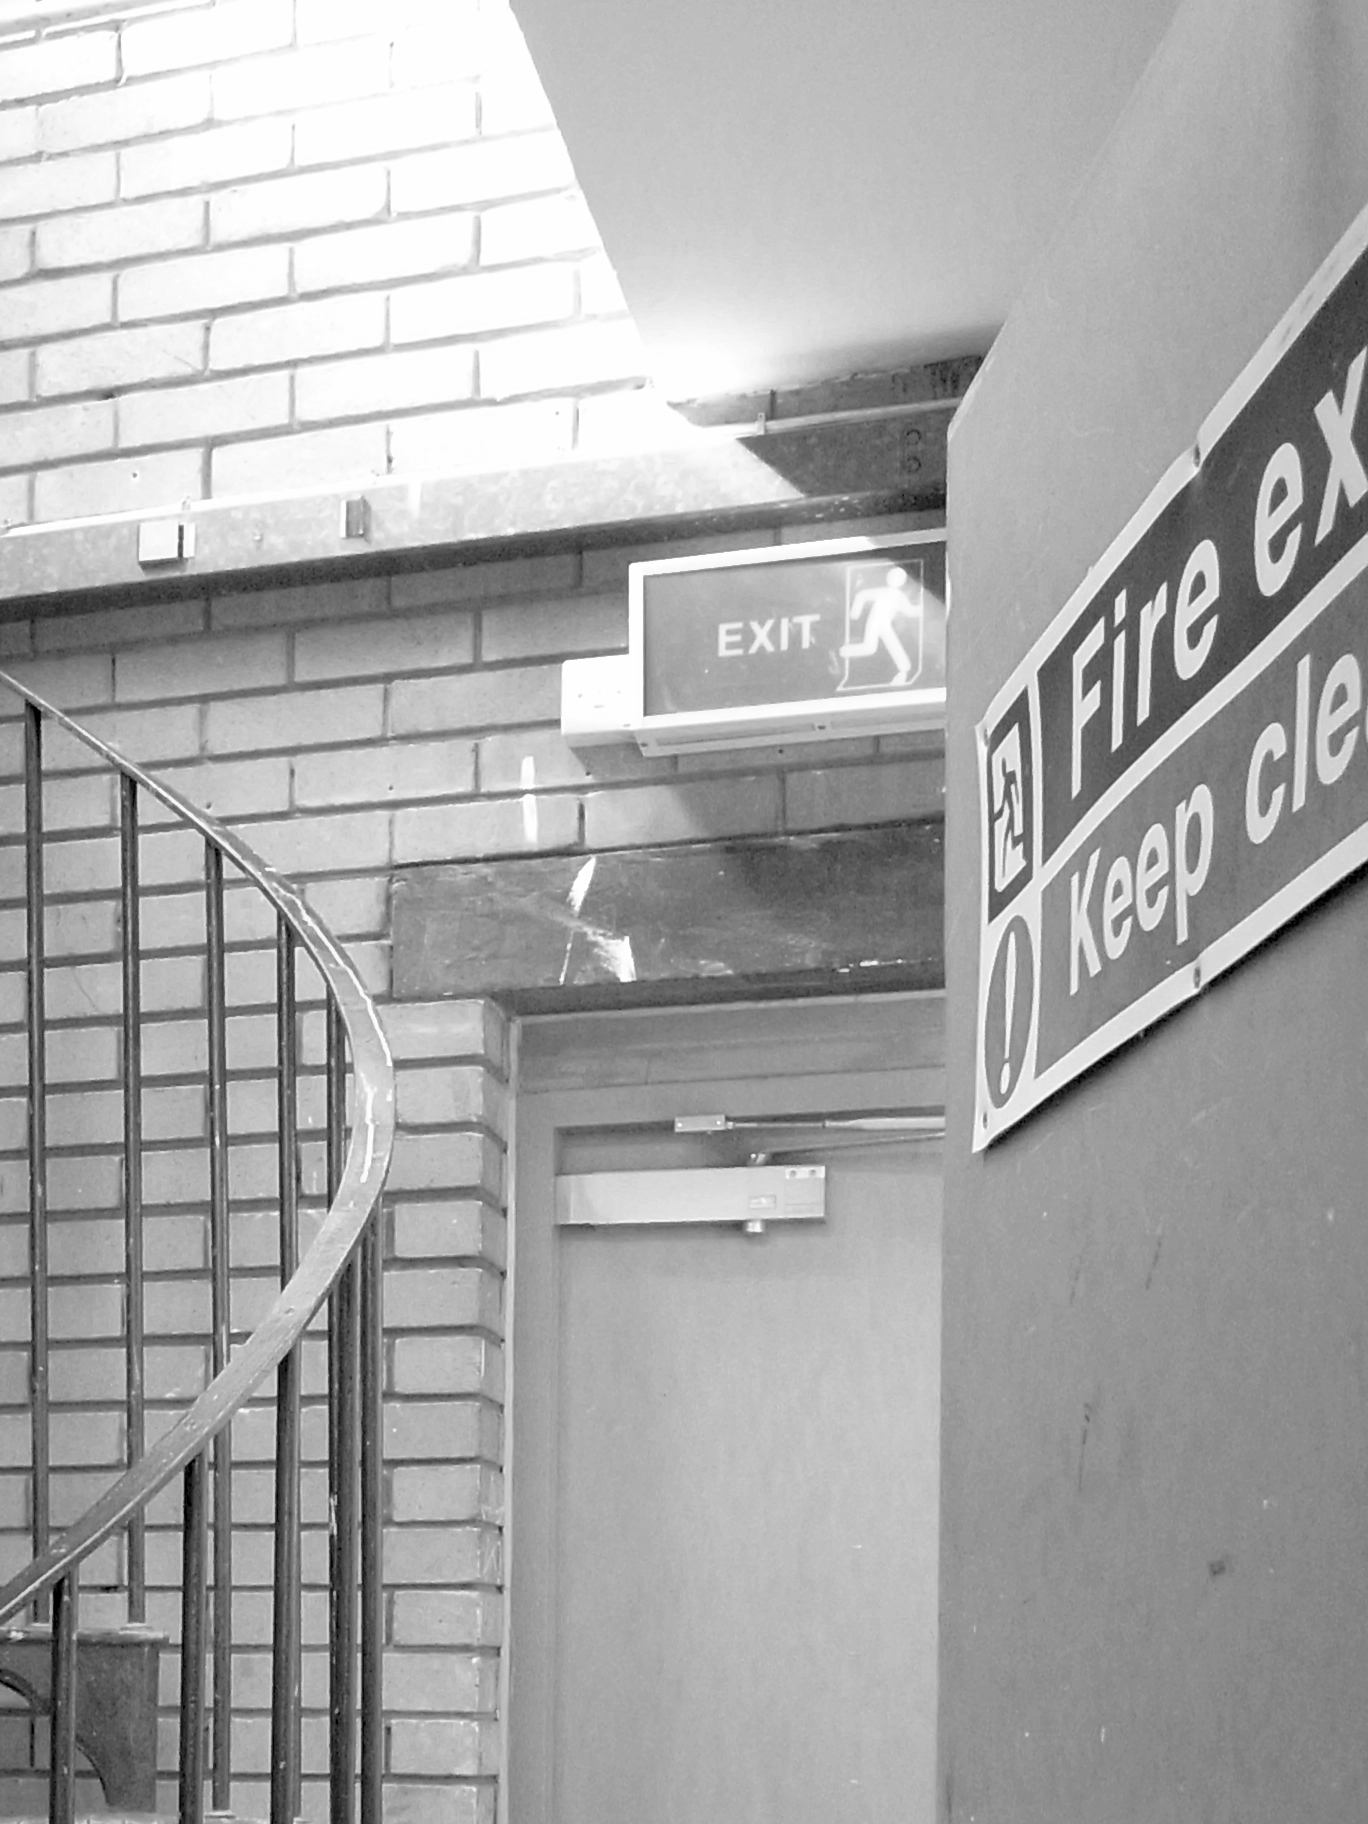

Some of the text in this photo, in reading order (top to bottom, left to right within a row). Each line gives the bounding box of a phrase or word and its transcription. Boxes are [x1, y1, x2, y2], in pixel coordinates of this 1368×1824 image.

[717, 613, 821, 657] EXIT
[1071, 345, 1368, 800] Fire ex
[1069, 652, 1368, 996] Keep cle
